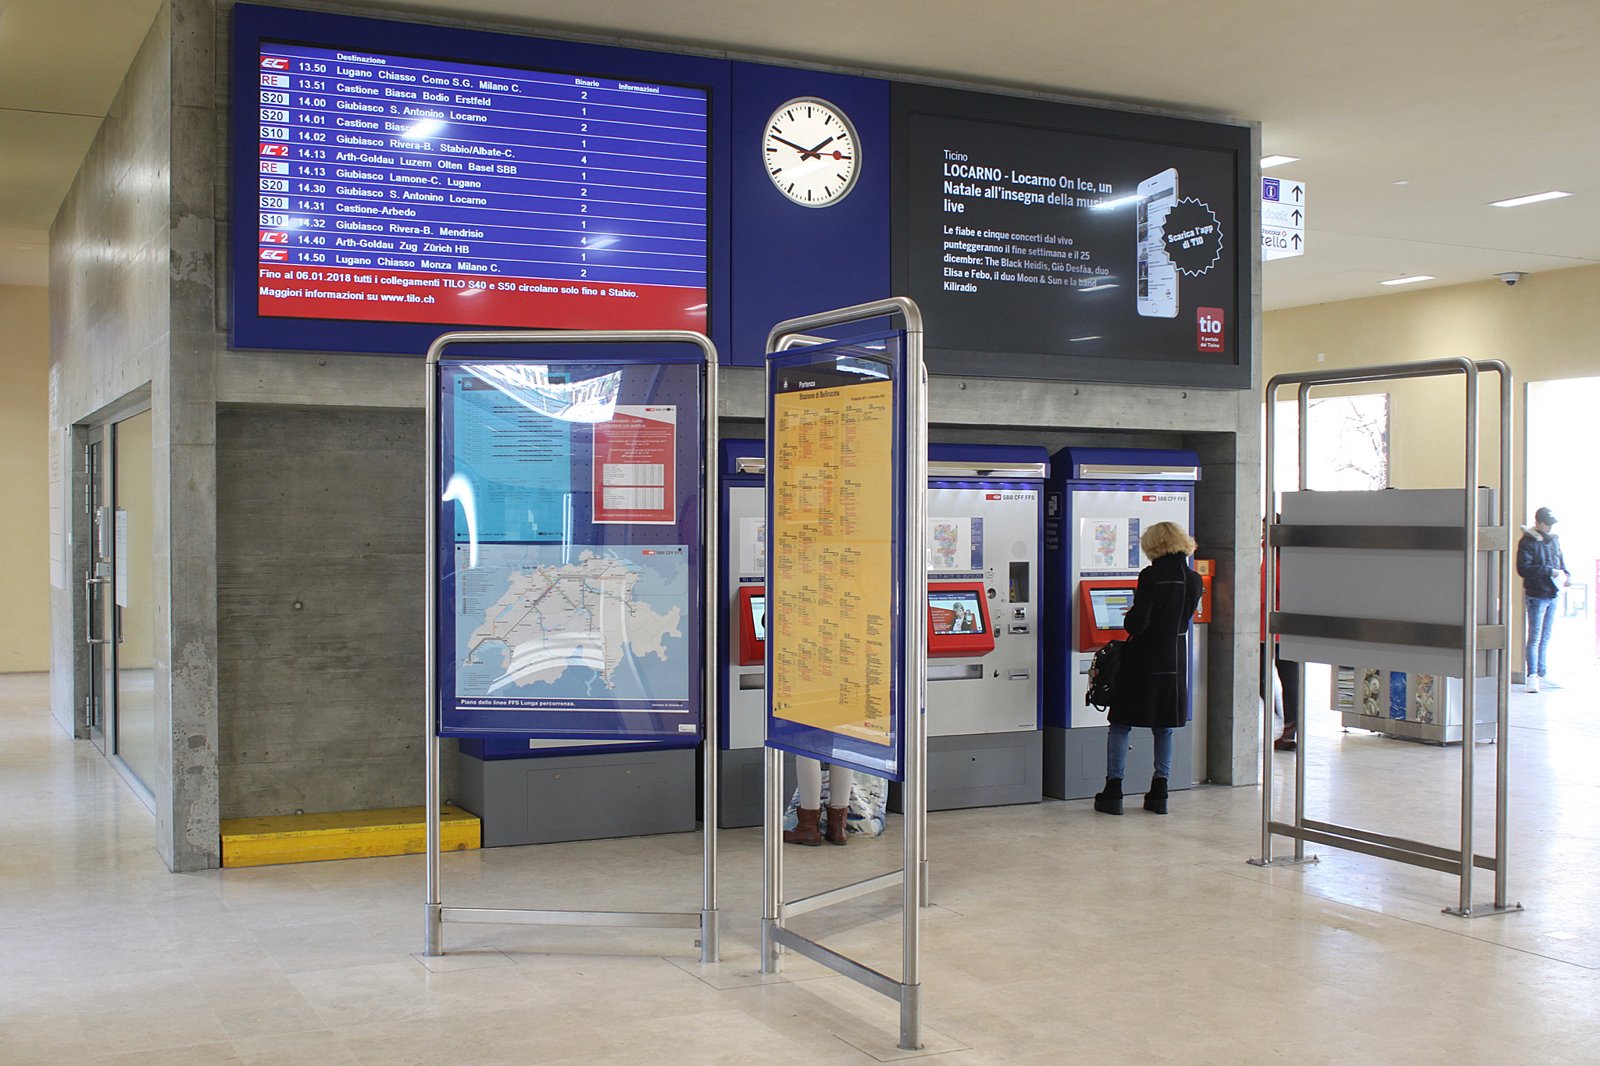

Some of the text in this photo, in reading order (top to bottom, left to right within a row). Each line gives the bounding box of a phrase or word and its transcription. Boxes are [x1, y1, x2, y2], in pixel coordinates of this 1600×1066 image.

[337, 53, 386, 64] Destinazione
[262, 58, 521, 92] EC 13.50 Lugano Chiasso Como S.G. Milano C.
[575, 79, 599, 87] Binario
[262, 76, 491, 106] RE 13.51 Castione Biasca Bodio Erstfeld
[619, 83, 659, 93] Informazioni
[262, 93, 487, 122] S20 14.00 Giubiasco S. Antonino Locarno
[262, 110, 413, 132] S20 14.01 Castione Biasc
[262, 128, 515, 158] S10 14.02 Giubiasco Rivera-B. Stabio/Albate-C.
[262, 145, 279, 155] IC
[281, 147, 288, 156] 2
[299, 149, 325, 158] 14.13
[336, 152, 394, 164] Arth-Goldau
[438, 160, 462, 169] Olten
[468, 163, 493, 172] Basel
[497, 165, 517, 174] SBB
[944, 150, 968, 162] Ticino
[262, 163, 481, 188] RE 14.13 Giubiasco Lamone-C. Lugano
[944, 163, 1112, 194] LOCARNO Locarno On Ice, un
[262, 181, 487, 205] S20 14.30 Giubiasco S. Antonino Locarno
[944, 181, 1073, 207] Natale all'insegna della
[262, 198, 416, 217] S20 14.31 Castione-Arbedo
[944, 199, 964, 213] live
[262, 215, 484, 238] S10 14.32 Giubiasco Rivera-B. Mendrisio
[944, 225, 1073, 246] Le fiabe cinque concerti dal vivo
[1168, 230, 1195, 242] Scarica
[262, 233, 469, 253] IC 2 14.40 Arth-Goldau Zug Zürich HB
[944, 241, 1090, 260] punteggeranno fine settimana 25
[1182, 236, 1204, 249] di TIO
[260, 250, 501, 272] EC 14.50 Lugano Chiasso Monza Milano C.
[944, 253, 983, 266] dicembre:
[985, 257, 999, 266] The
[1001, 258, 1022, 268] Black
[1024, 260, 1050, 272] Heidis,
[1052, 262, 1064, 272] Giò
[1095, 265, 1109, 276] duo
[260, 270, 638, 298] Fino al 06.01.2018 tutti collegamenti TILO S40 S50 circolano solo fino Stabio.
[944, 268, 1097, 287] Elisa Febo, duo Moon & Sun la band
[944, 281, 977, 293] Kiliradio
[260, 287, 302, 298] Maggiori
[305, 289, 364, 300] informazioni
[381, 293, 435, 304] www.tilo.ch
[1200, 315, 1221, 334] tio
